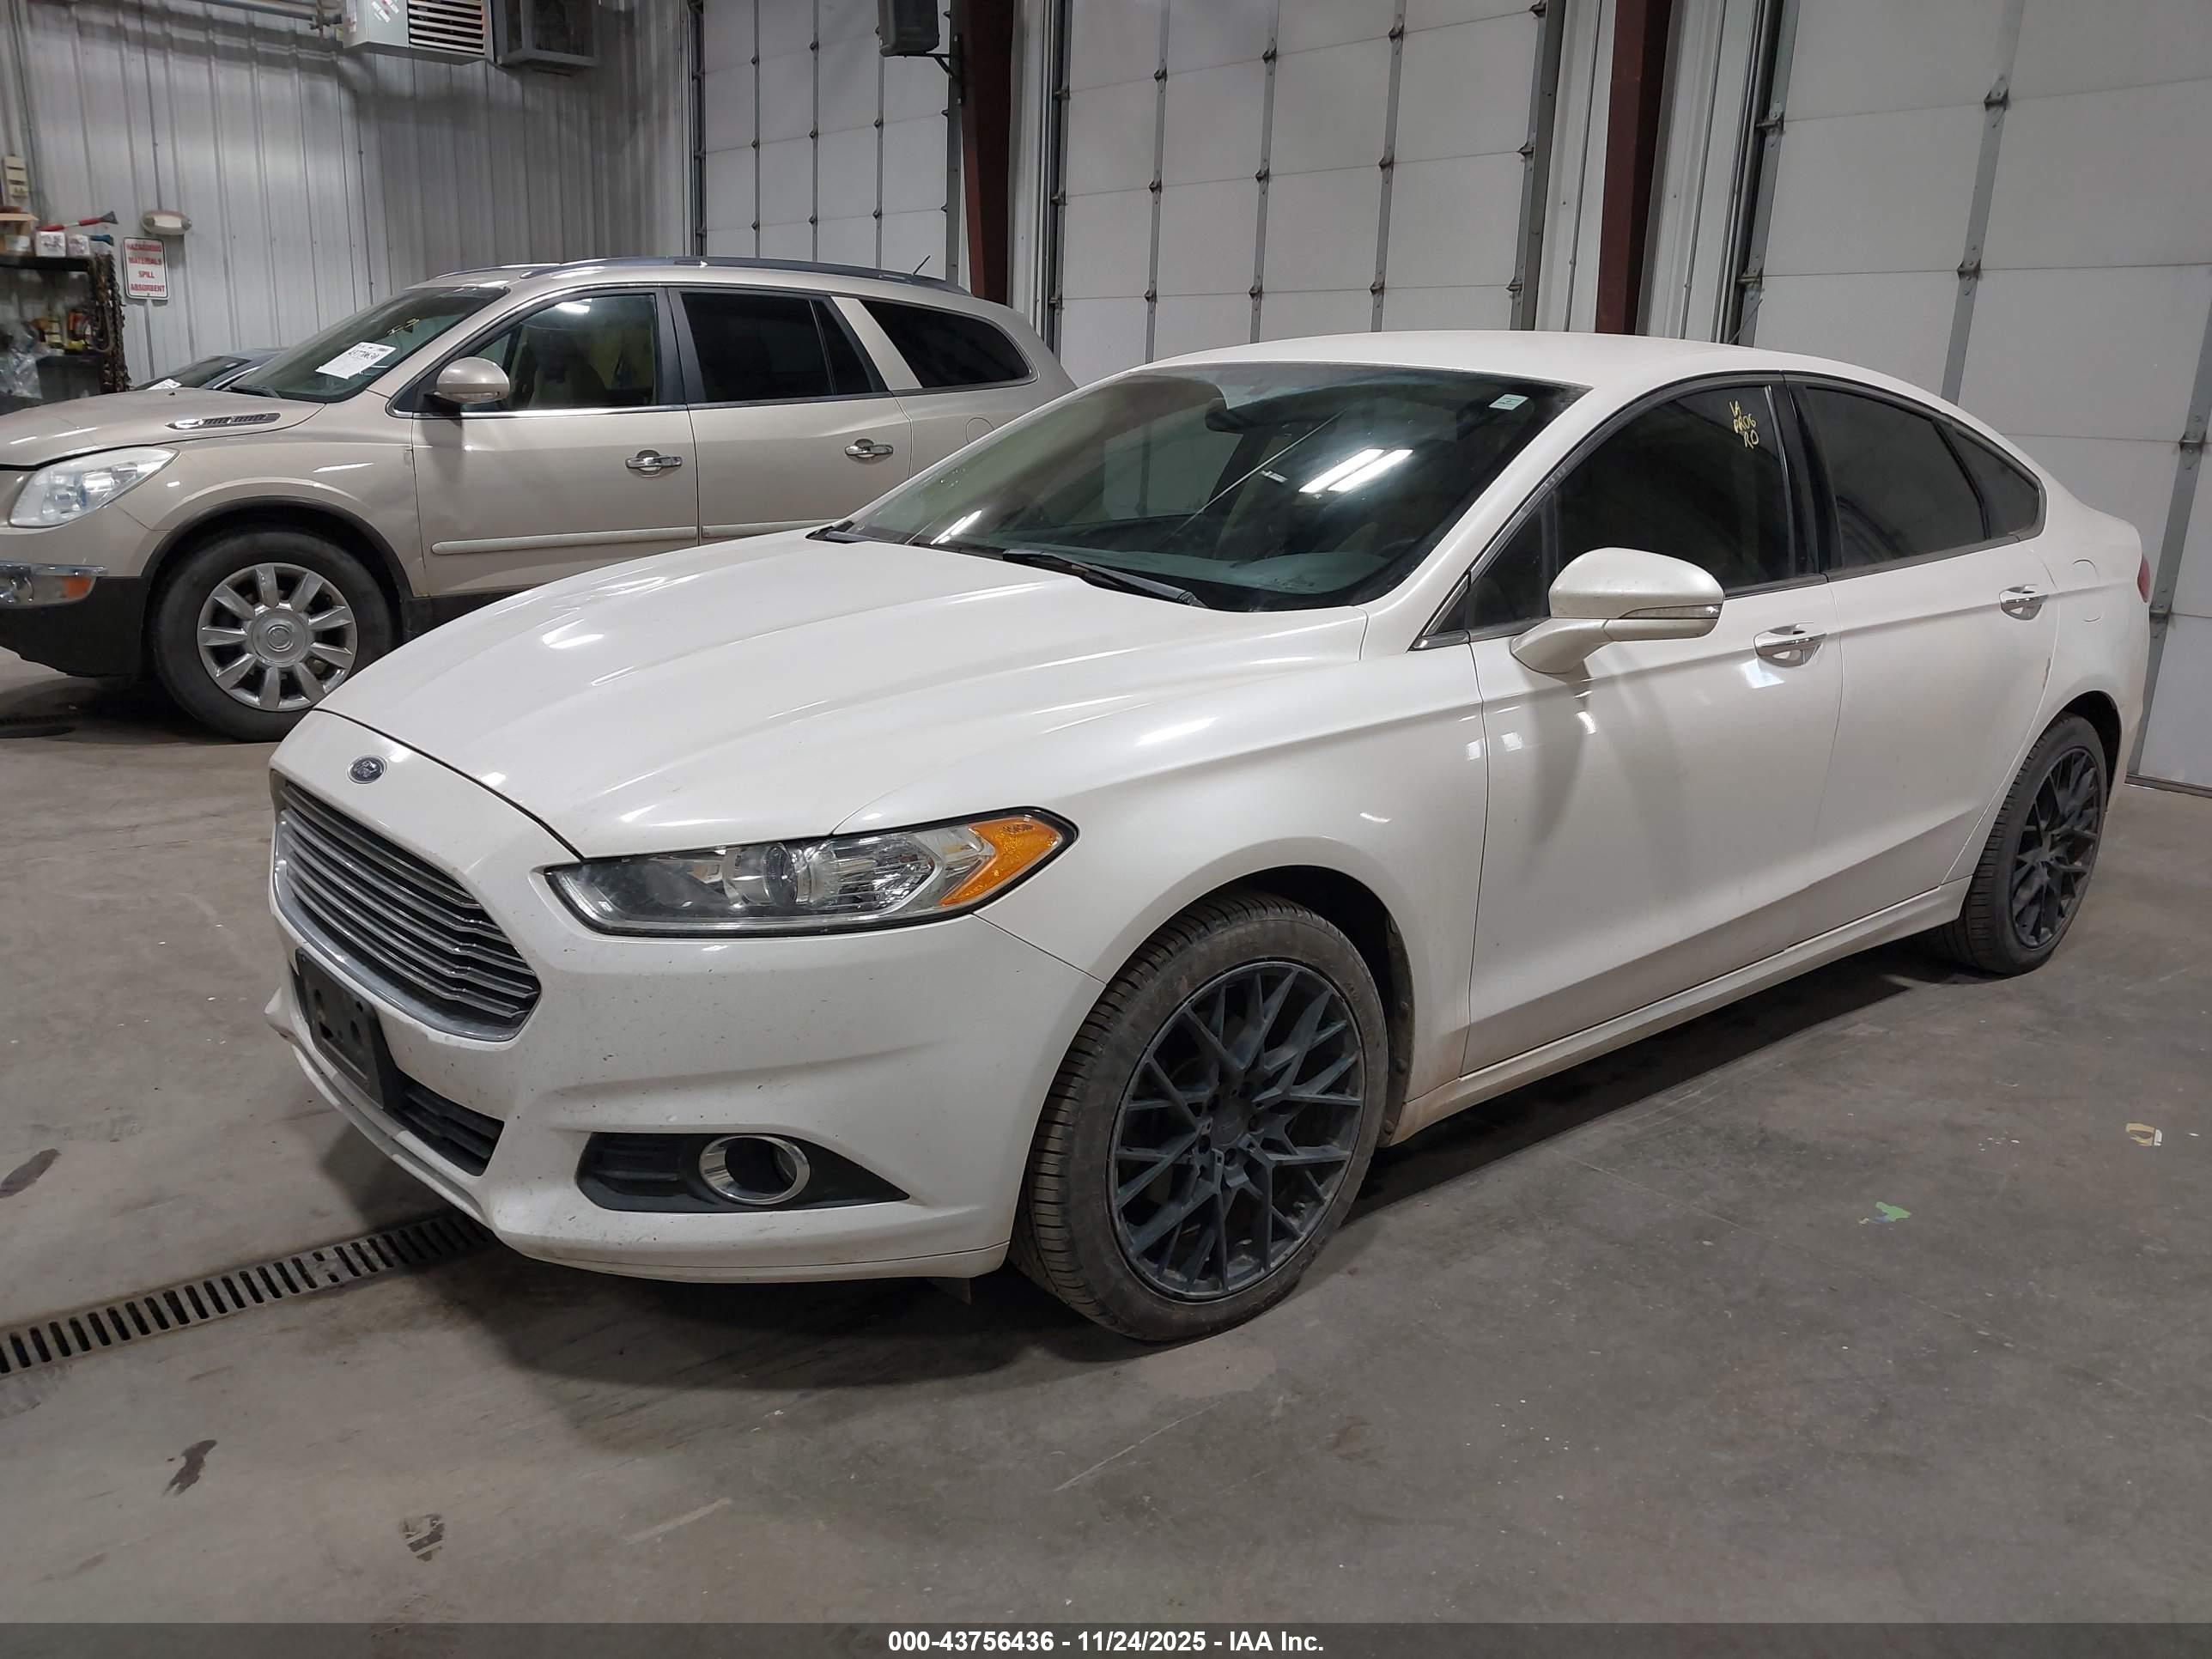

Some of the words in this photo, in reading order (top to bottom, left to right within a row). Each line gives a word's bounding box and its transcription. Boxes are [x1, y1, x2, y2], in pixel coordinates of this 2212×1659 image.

[128, 257, 162, 265] MATERIALS
[138, 270, 155, 279] SPILL
[131, 283, 165, 292] ABSORBENT
